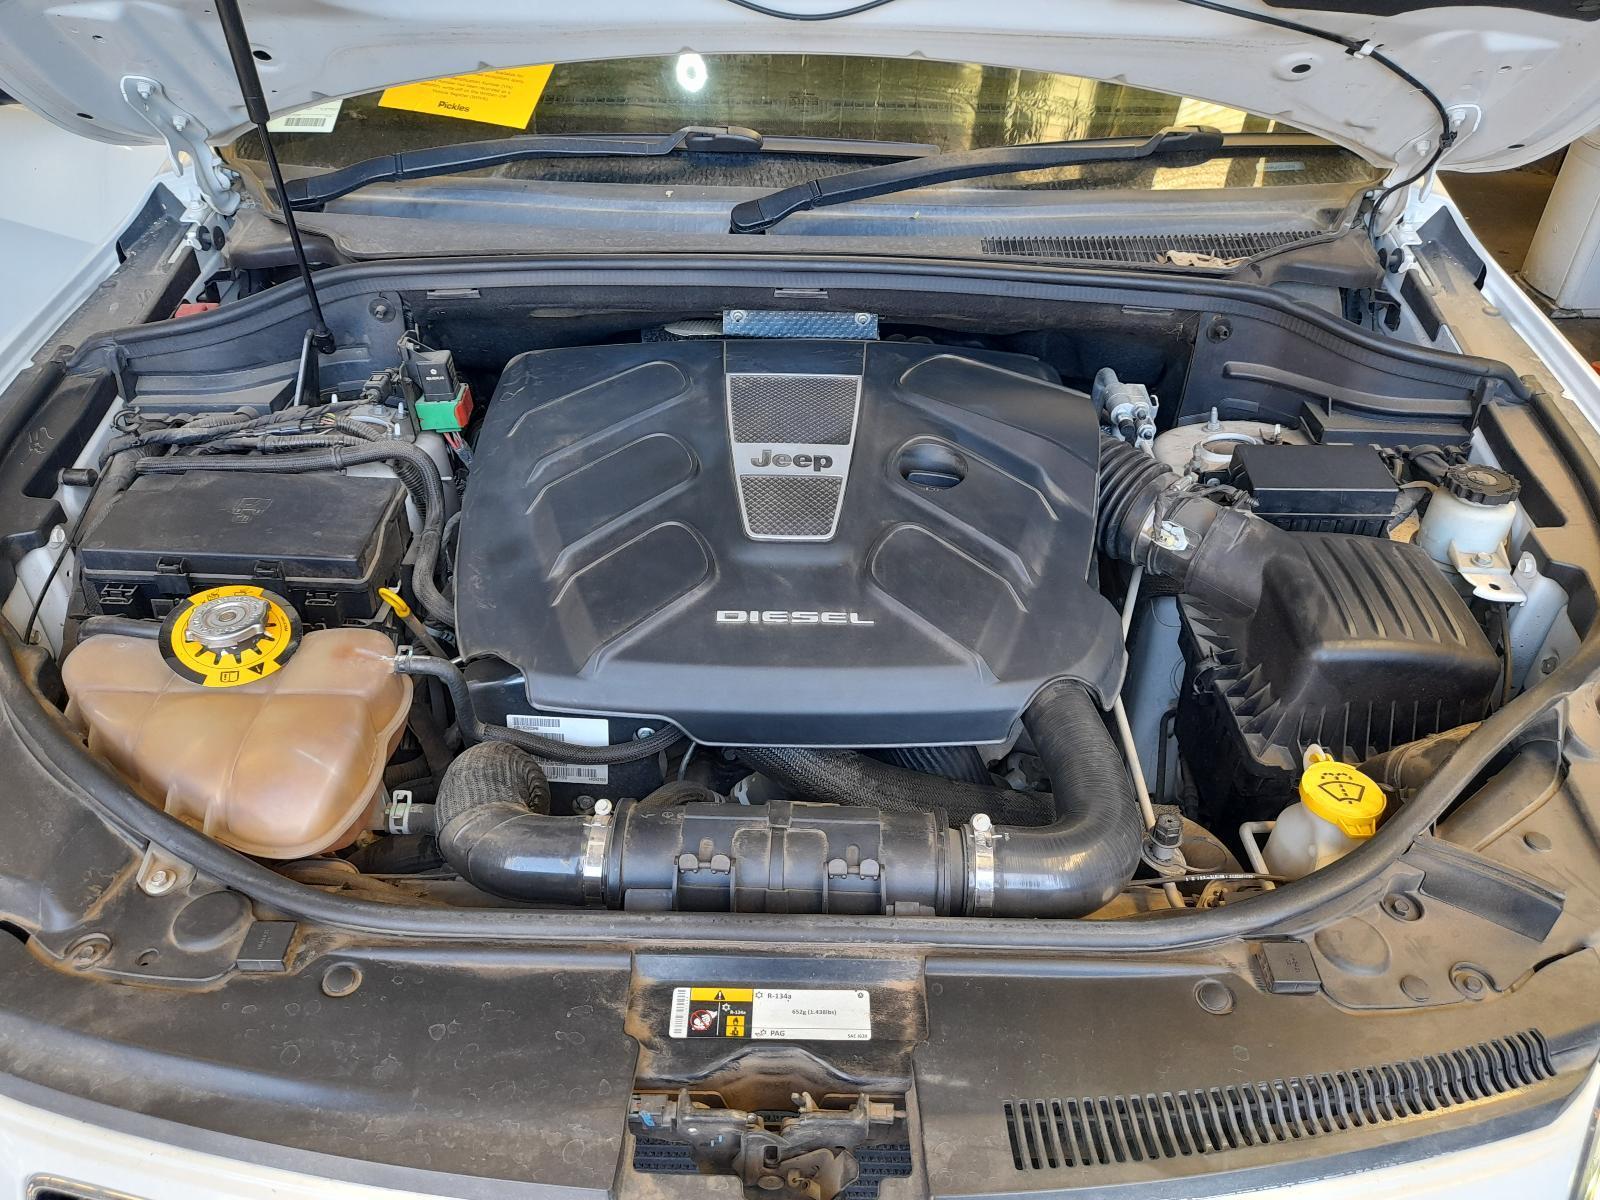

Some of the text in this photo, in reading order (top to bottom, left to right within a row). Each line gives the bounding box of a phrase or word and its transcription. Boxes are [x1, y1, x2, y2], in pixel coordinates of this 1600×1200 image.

[438, 100, 470, 112] Pickles
[751, 449, 833, 472] Jeep
[716, 610, 875, 625] DIESEL
